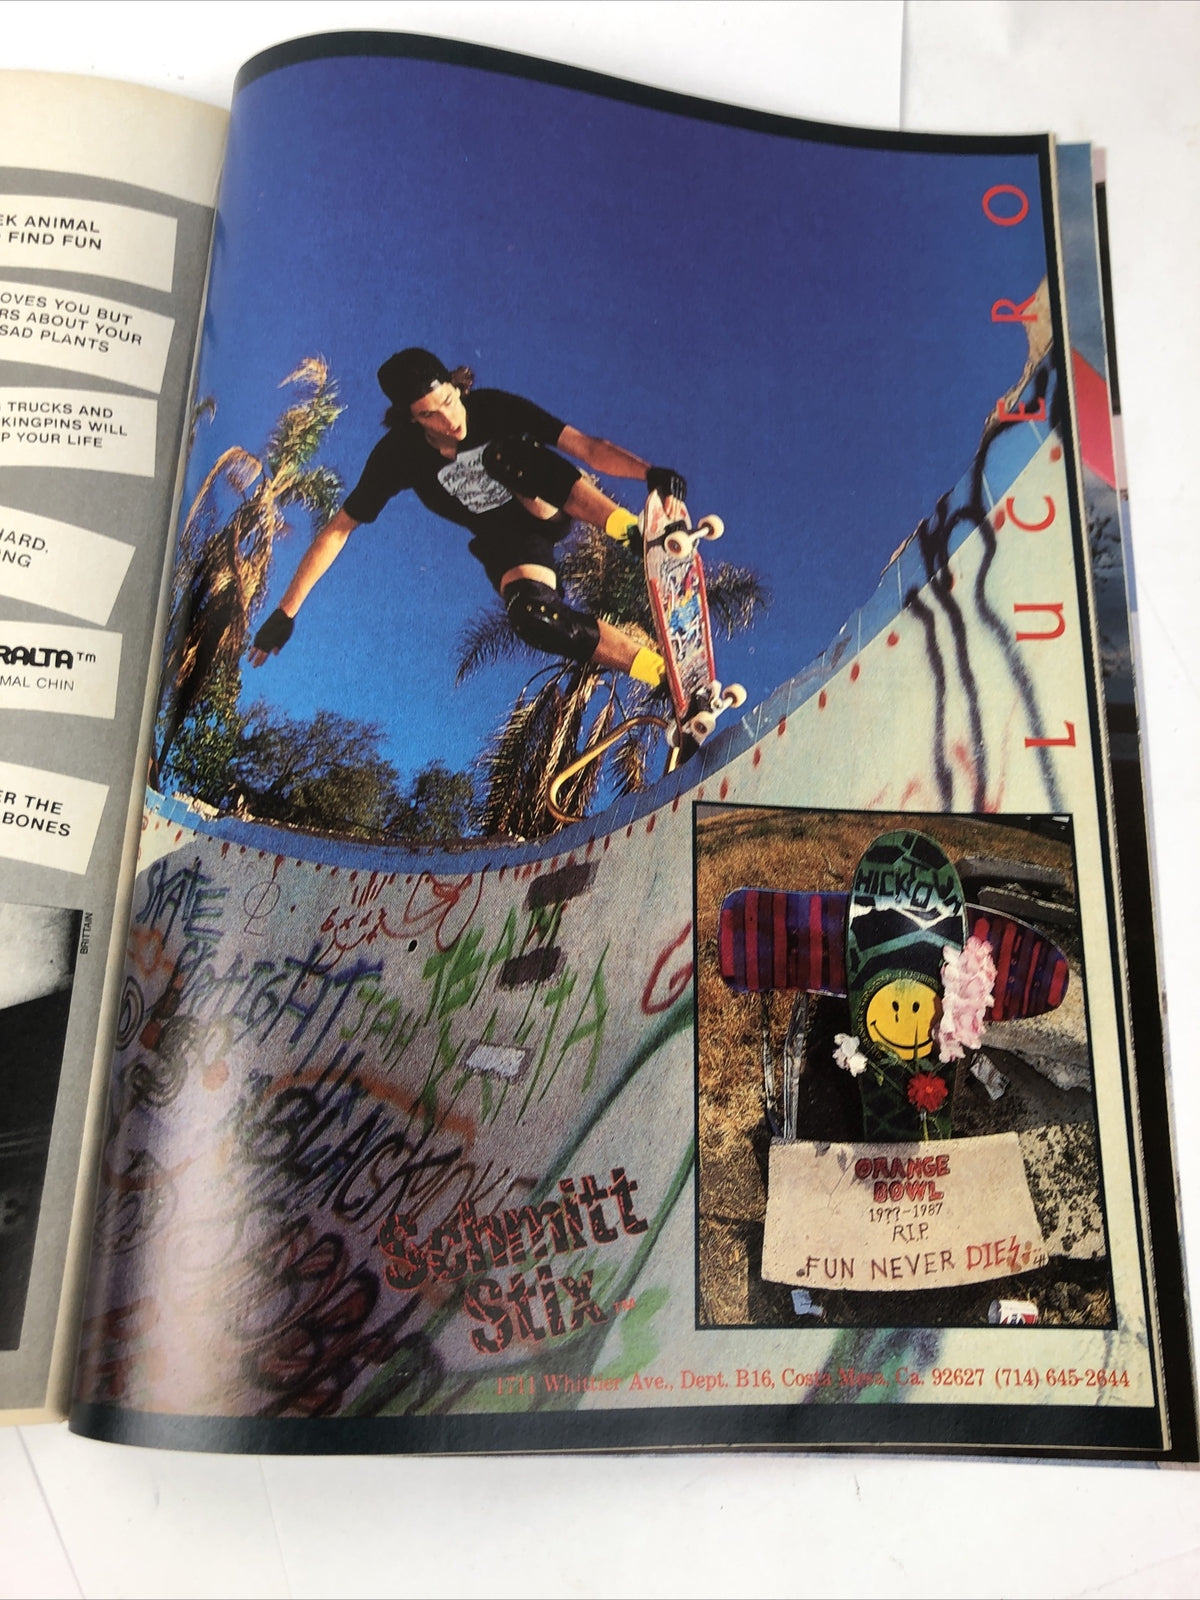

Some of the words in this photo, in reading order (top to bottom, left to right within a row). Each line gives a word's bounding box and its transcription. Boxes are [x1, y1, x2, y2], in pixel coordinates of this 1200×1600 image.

[24, 215, 101, 233] ANIMAL
[8, 231, 55, 246] FIND
[62, 234, 103, 250] FUN
[54, 299, 91, 316] YOU
[97, 308, 133, 326] BUT
[0, 324, 34, 339] SAD
[40, 331, 110, 353] PLANTS
[26, 313, 89, 332] ABOUT
[95, 323, 143, 346] YOUR
[8, 401, 73, 415] TRUCKS
[78, 405, 114, 419] AND
[1, 417, 82, 431] KINGPINS
[88, 421, 128, 436] WILL
[17, 432, 62, 445] YOUR
[68, 436, 103, 449] LIFE
[982, 184, 1077, 749] LUCERO
[0, 674, 31, 688] MAL
[36, 676, 75, 692] CHIN
[24, 795, 64, 815] THE
[2, 811, 72, 837] BONES
[80, 911, 93, 955] BRITTAIN
[854, 1154, 951, 1180] ORANGE
[873, 1180, 945, 1204] BOWL
[378, 1167, 649, 1292] Schmitt
[804, 1255, 855, 1280] FUN
[871, 1250, 955, 1281] NEVER
[464, 1264, 609, 1354] Stix
[496, 1375, 536, 1395] 1711
[543, 1372, 622, 1394] Whittier
[681, 1370, 729, 1391] Dept.
[736, 1369, 775, 1389] B16,
[781, 1368, 832, 1388] Costa
[895, 1368, 925, 1387] Ca.
[931, 1368, 985, 1387] 92627
[994, 1368, 1040, 1390] (714)
[1046, 1368, 1131, 1389] 645-2644
